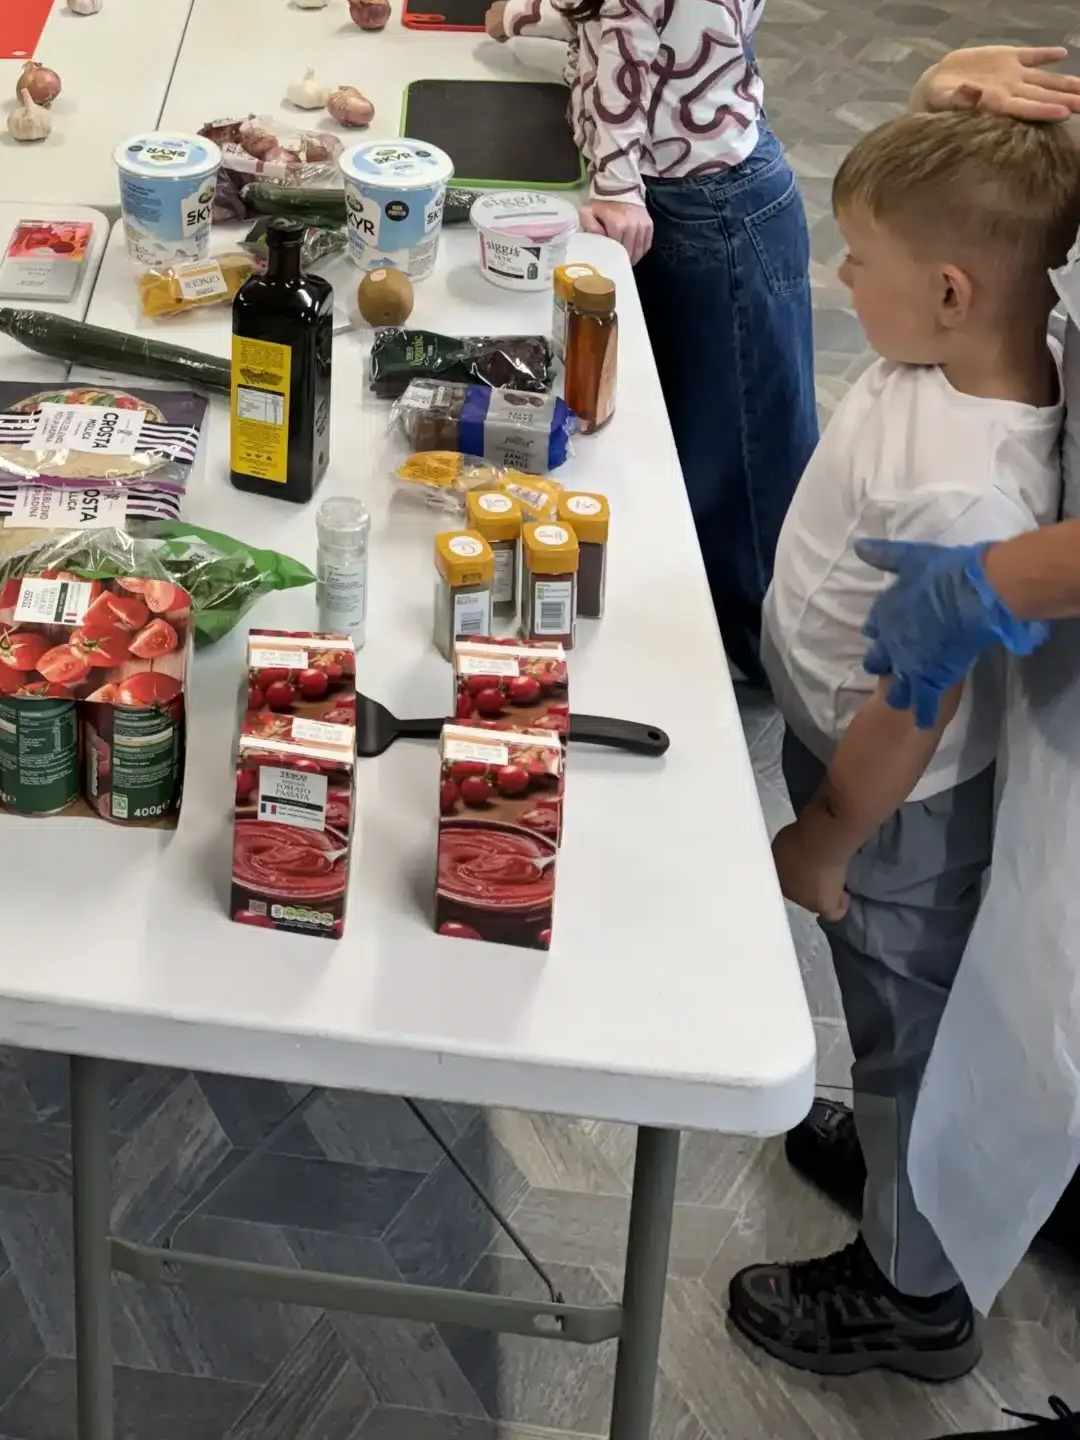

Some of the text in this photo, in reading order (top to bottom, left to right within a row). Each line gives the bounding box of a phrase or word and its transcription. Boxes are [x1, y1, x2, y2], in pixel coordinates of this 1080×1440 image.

[186, 205, 211, 226] SKY
[183, 275, 220, 290] GINGER
[81, 418, 98, 441] MOLLICA
[92, 412, 120, 450] CROSTA
[67, 491, 78, 511] LLICA
[80, 489, 100, 522] OSTA
